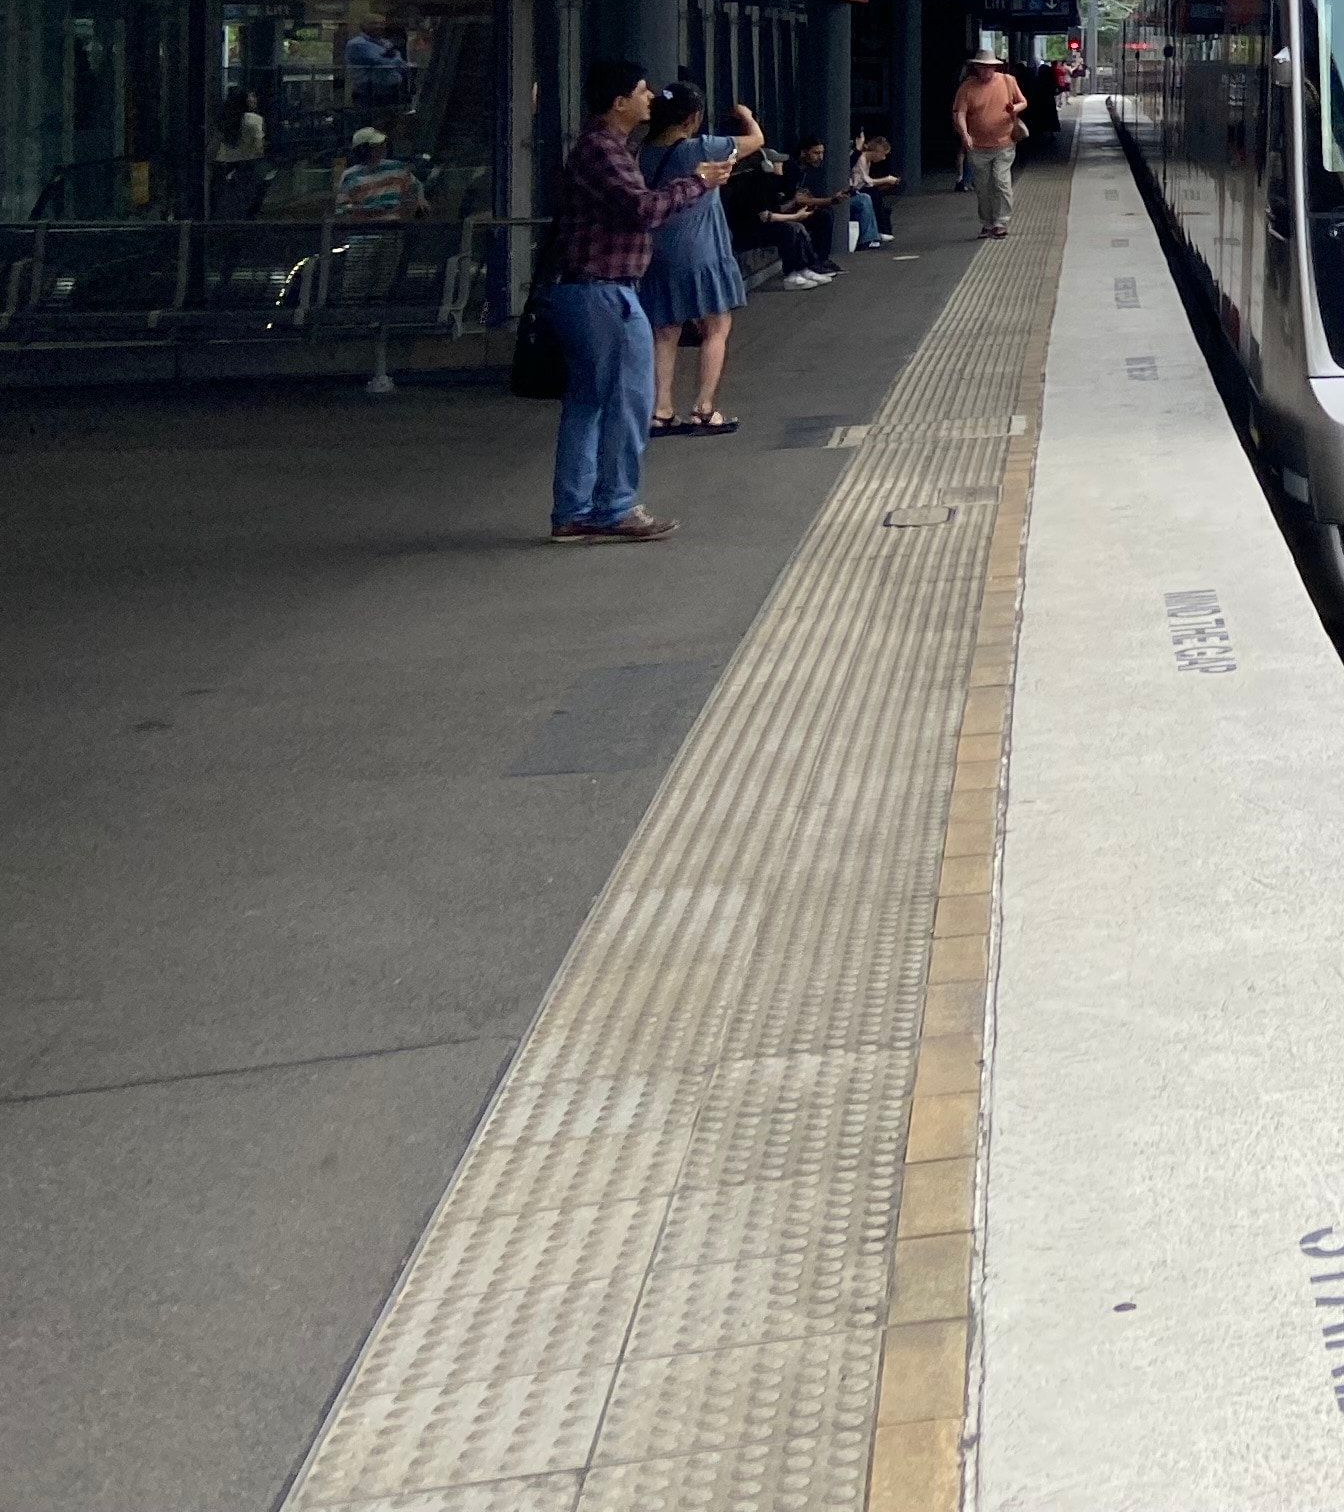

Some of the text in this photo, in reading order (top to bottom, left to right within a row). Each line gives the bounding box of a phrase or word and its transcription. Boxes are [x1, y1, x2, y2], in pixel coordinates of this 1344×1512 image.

[1163, 589, 1237, 674] MIND THE GAP
